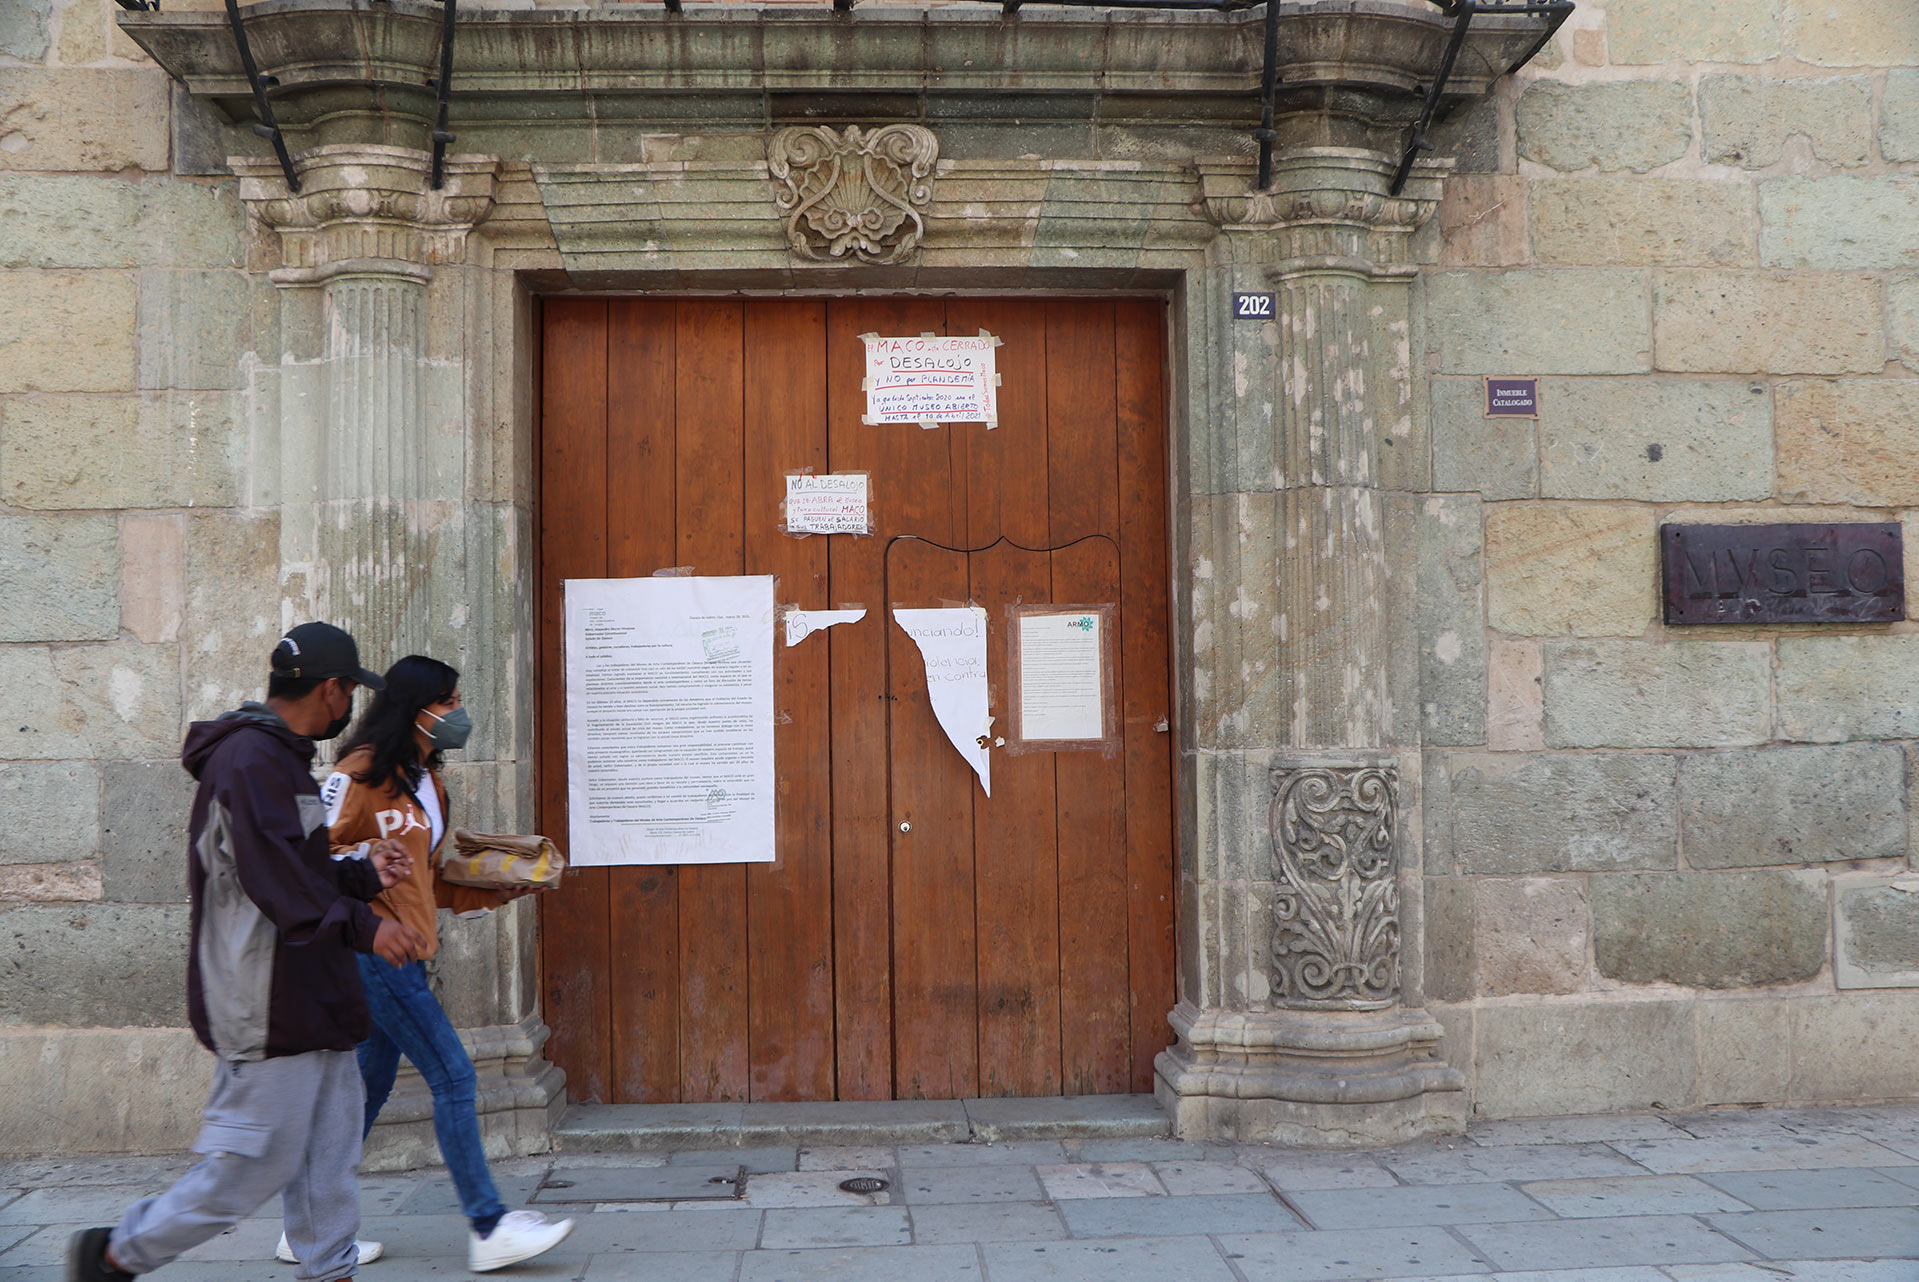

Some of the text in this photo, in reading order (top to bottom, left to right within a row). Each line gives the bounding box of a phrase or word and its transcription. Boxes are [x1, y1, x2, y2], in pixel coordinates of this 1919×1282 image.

[1238, 295, 1270, 315] 202
[877, 339, 925, 353] MACO
[942, 339, 991, 351] CERRADO
[886, 375, 901, 384] NO
[936, 393, 952, 401] 2020
[911, 403, 942, 411] MUSEO
[945, 402, 979, 411] ABIERTO
[791, 479, 864, 491] NO AL DESALOJO
[811, 496, 833, 504] ABRA
[841, 505, 865, 514] MACO
